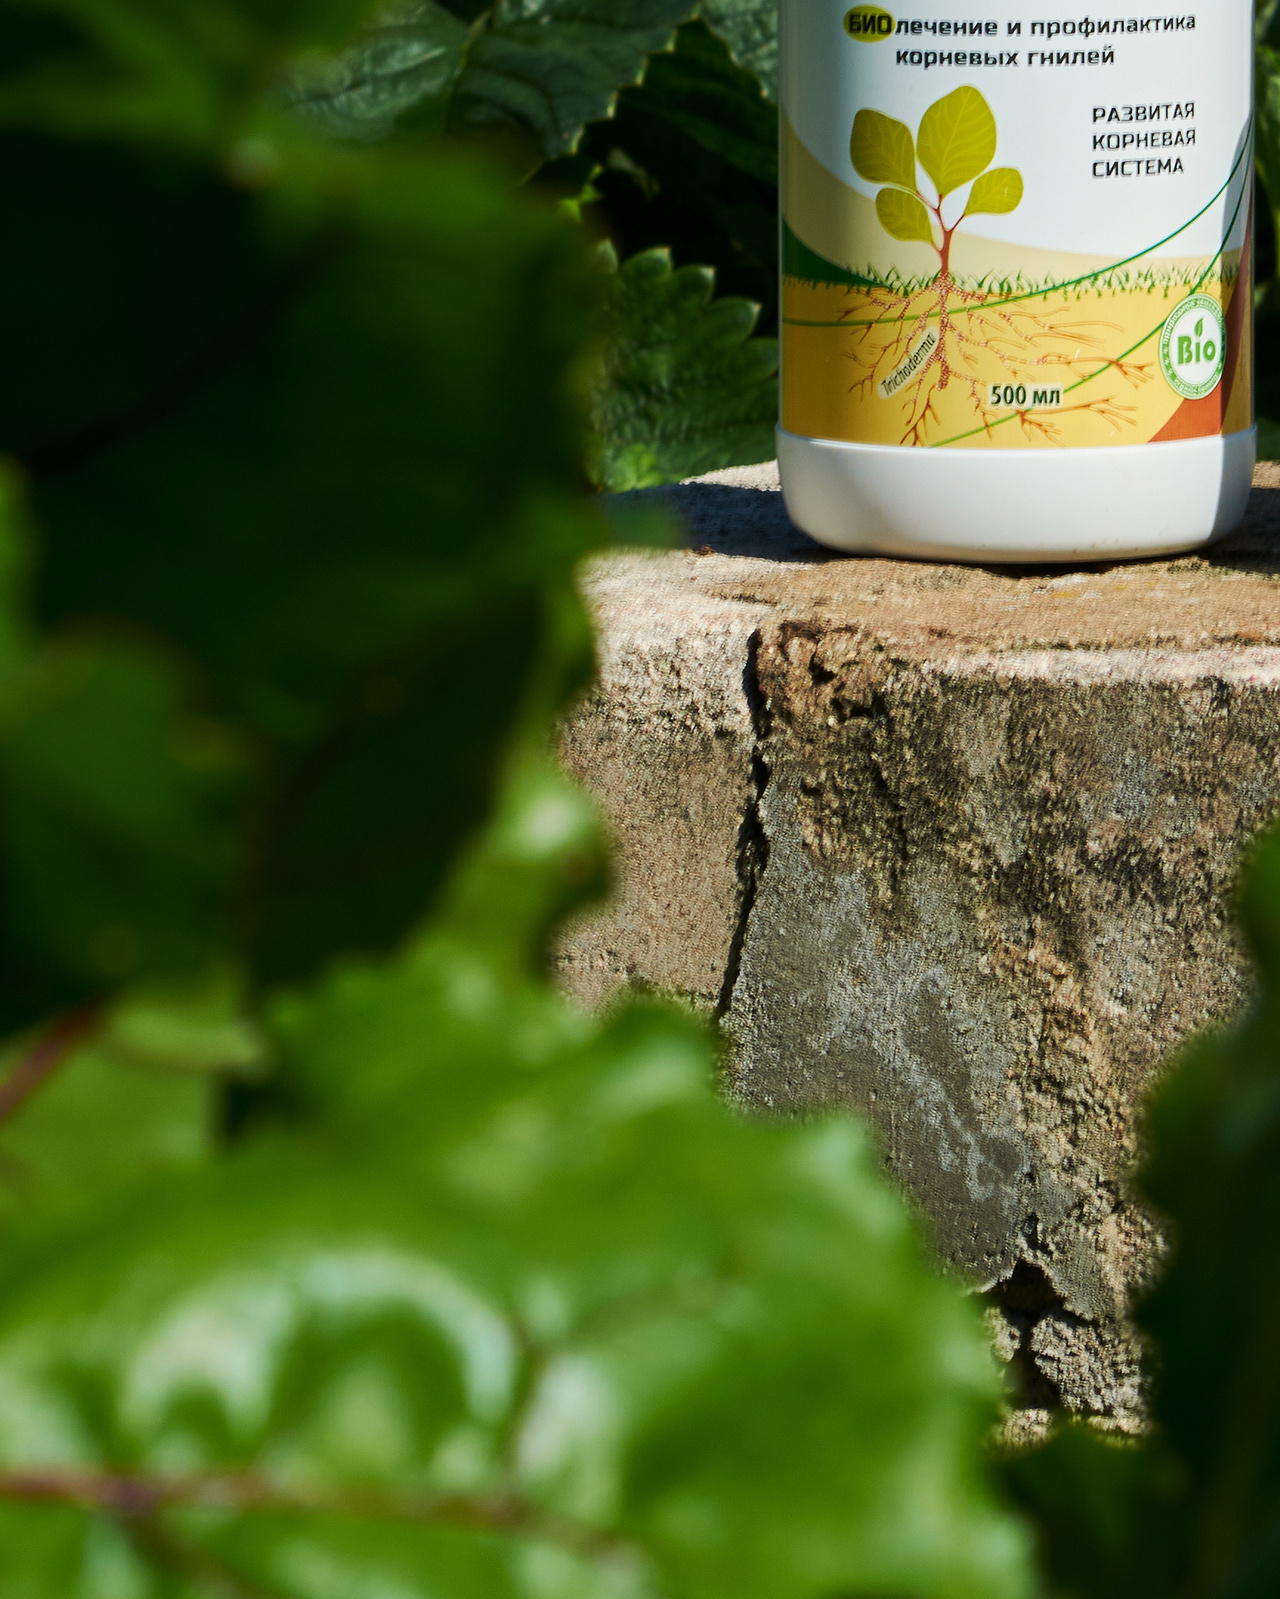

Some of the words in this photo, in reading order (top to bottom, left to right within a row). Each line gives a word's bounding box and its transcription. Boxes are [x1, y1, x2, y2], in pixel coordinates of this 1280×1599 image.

[1007, 19, 1022, 36] и
[1031, 13, 1196, 41] профилактика
[895, 48, 1018, 71] корневых
[1028, 43, 1115, 65] гнилей
[1092, 101, 1196, 123] РАЗВИТАЯ
[1091, 129, 1196, 151] КОРНЕВАЯ
[1091, 157, 1184, 178] СИСТЕМА
[1177, 335, 1216, 366] Bio
[880, 332, 937, 396] Trichoderma
[990, 385, 1028, 406] 500
[1032, 389, 1061, 406] мл
